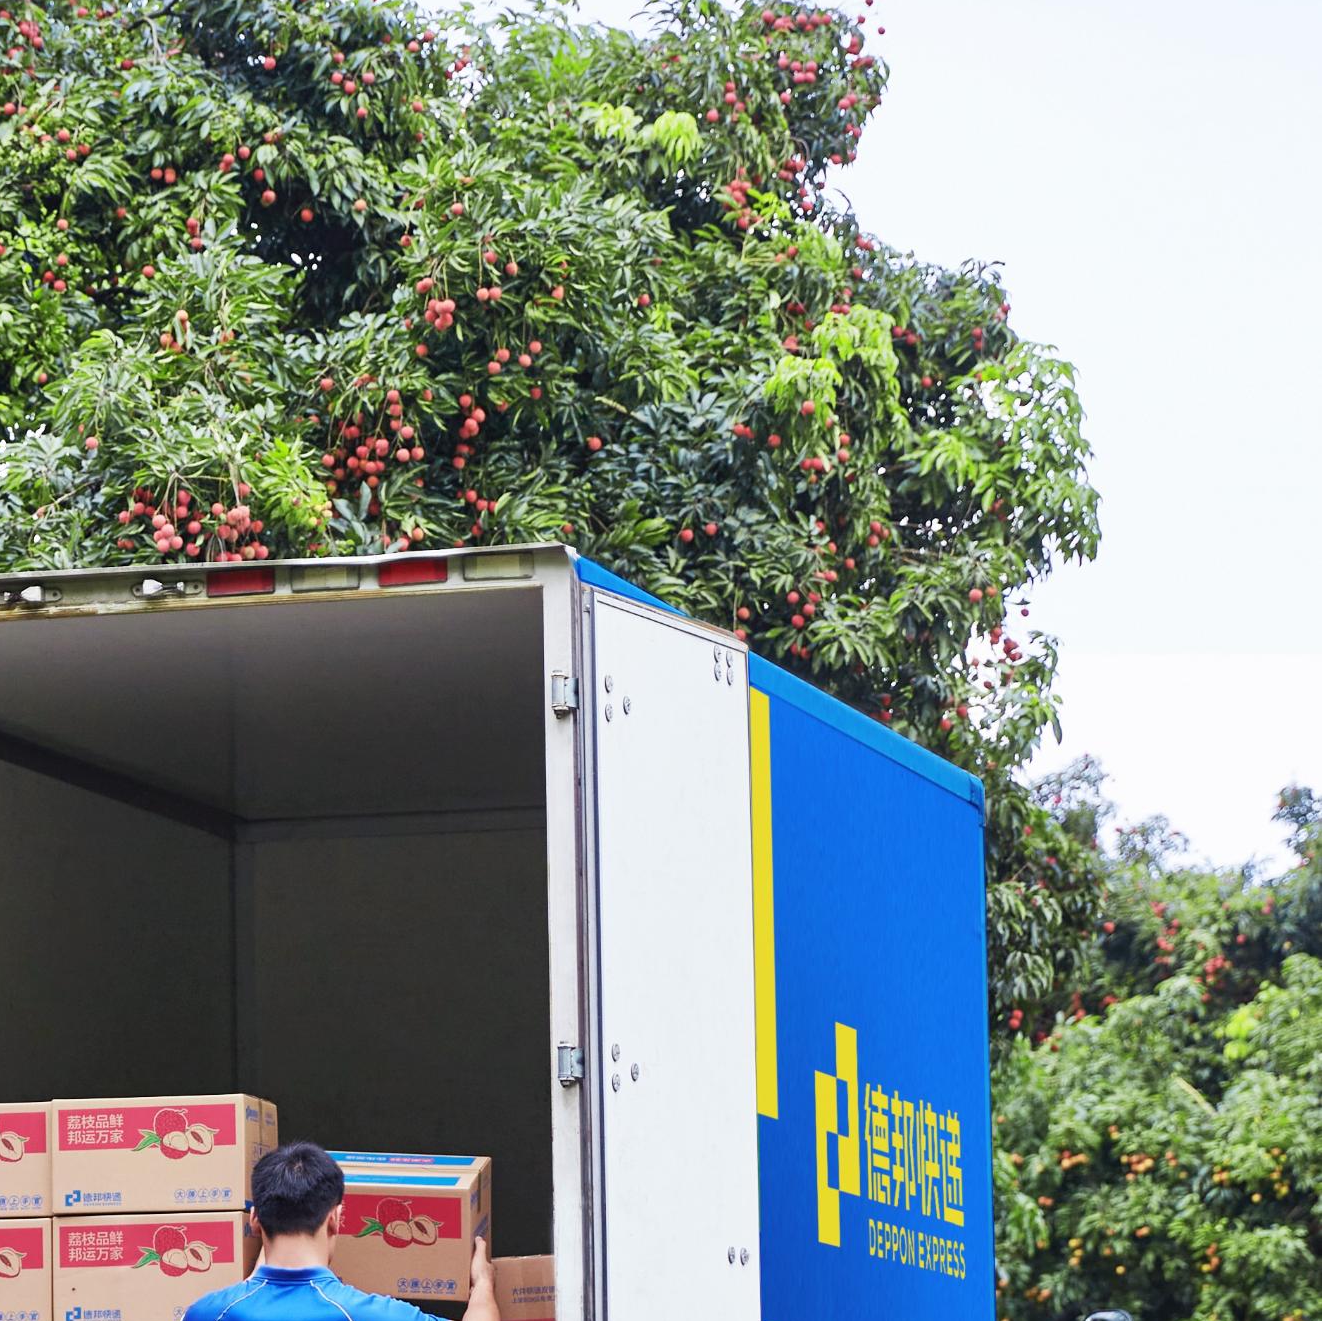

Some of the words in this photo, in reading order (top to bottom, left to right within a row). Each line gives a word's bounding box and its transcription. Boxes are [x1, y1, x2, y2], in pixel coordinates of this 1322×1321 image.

[68, 1114, 123, 1129] 荔枝品鲜
[68, 1129, 123, 1144] 邦运万家
[865, 1083, 964, 1227] 德邦快递
[69, 1231, 123, 1246] 荔枝品鲜
[69, 1247, 123, 1261] 邦运万家
[868, 1218, 915, 1266] DEPPON
[918, 1232, 966, 1280] EXPRESS
